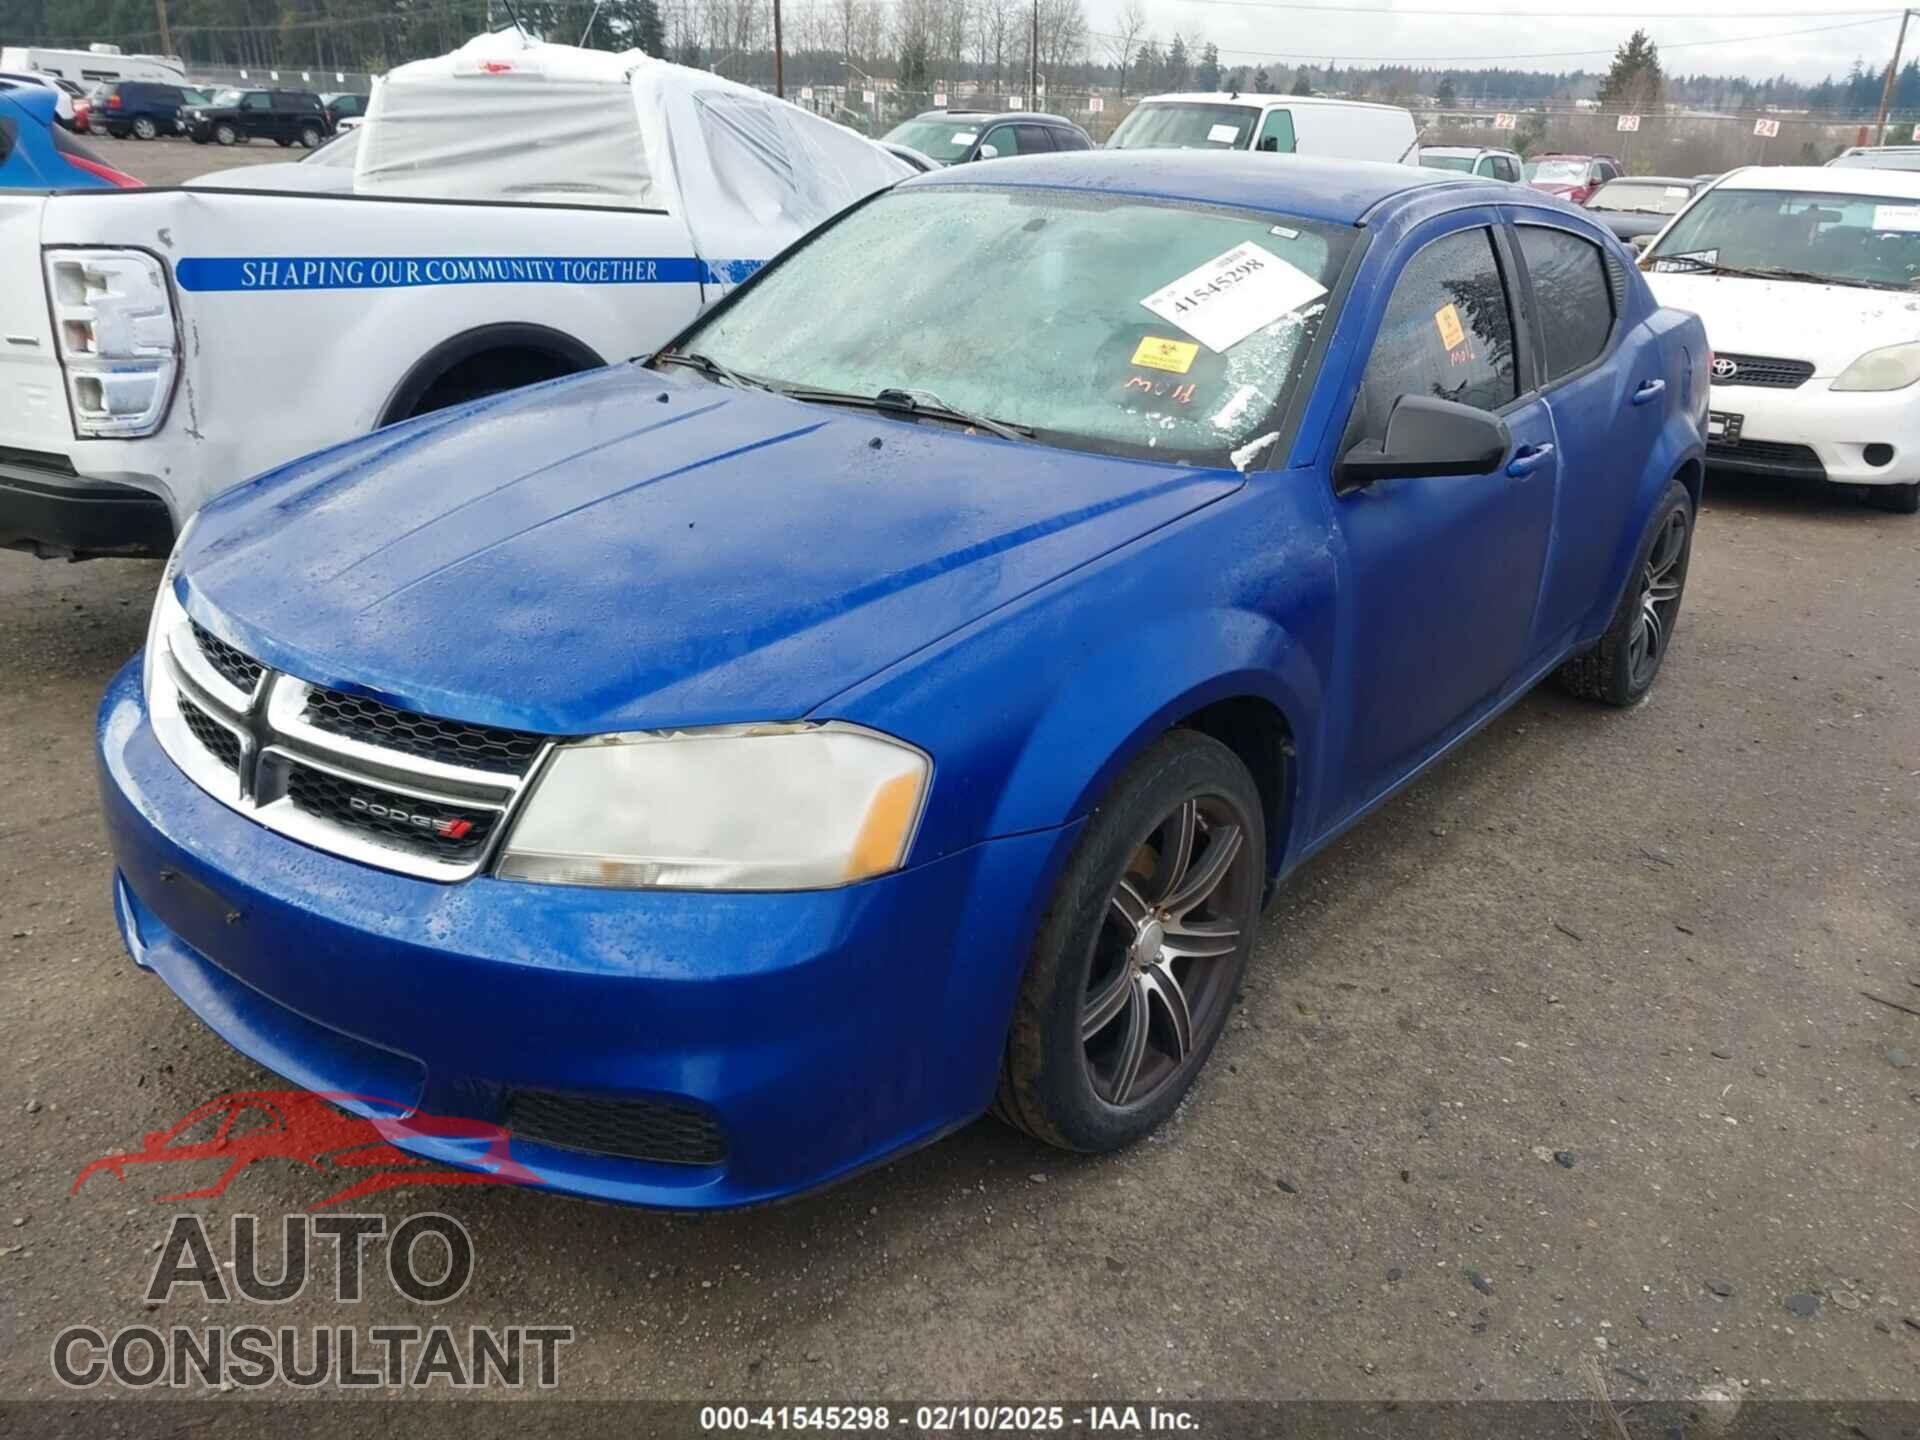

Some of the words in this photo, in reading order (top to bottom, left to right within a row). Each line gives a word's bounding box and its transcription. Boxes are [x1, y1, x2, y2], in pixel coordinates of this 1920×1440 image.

[241, 260, 364, 287] SHAPING
[371, 260, 421, 284] OUR
[425, 259, 555, 283] COMMUNITY
[561, 260, 657, 281] TOGETHER
[1174, 257, 1265, 314] 41545298
[350, 797, 453, 832] DODGE
